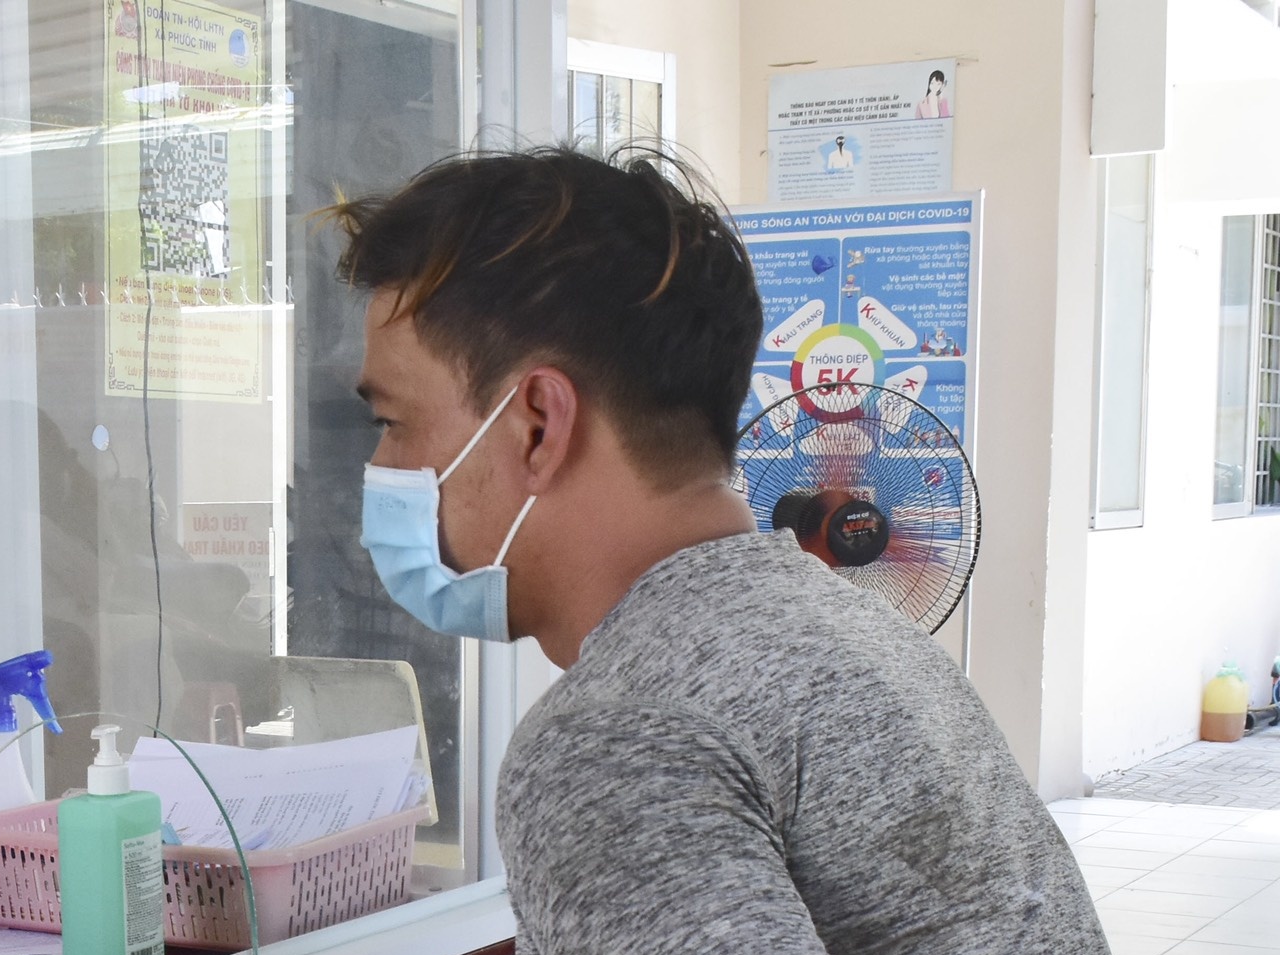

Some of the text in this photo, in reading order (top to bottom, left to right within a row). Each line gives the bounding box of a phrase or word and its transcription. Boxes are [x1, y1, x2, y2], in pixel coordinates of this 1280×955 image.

[725, 219, 758, 229] HUNG
[794, 217, 809, 226] AN
[812, 214, 841, 225] TOÀN
[845, 212, 864, 223] VỚI
[867, 212, 885, 223] ĐẠI
[888, 210, 915, 222] DỊCH
[918, 207, 969, 219] COVID-19
[797, 309, 823, 331] TRANG
[810, 353, 868, 366] THÔNG ĐIỆP
[817, 368, 859, 396] 5K
